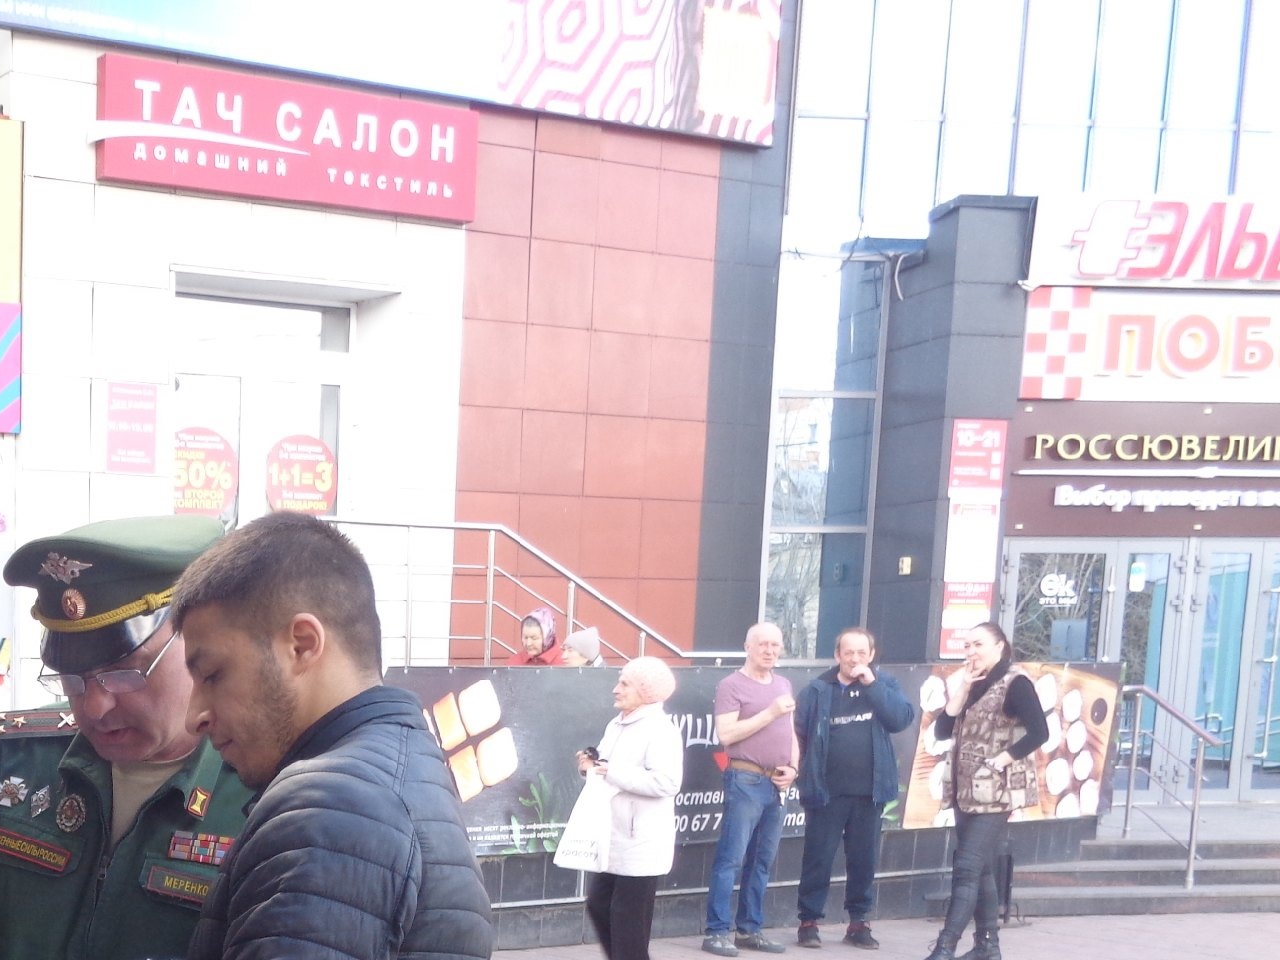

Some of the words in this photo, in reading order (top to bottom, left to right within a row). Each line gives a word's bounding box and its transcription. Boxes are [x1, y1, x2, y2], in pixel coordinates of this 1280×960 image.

[133, 79, 243, 134] ТАЧ
[275, 102, 455, 163] САЛОН
[269, 461, 333, 493] 1+1=3
[691, 814, 710, 831] 67
